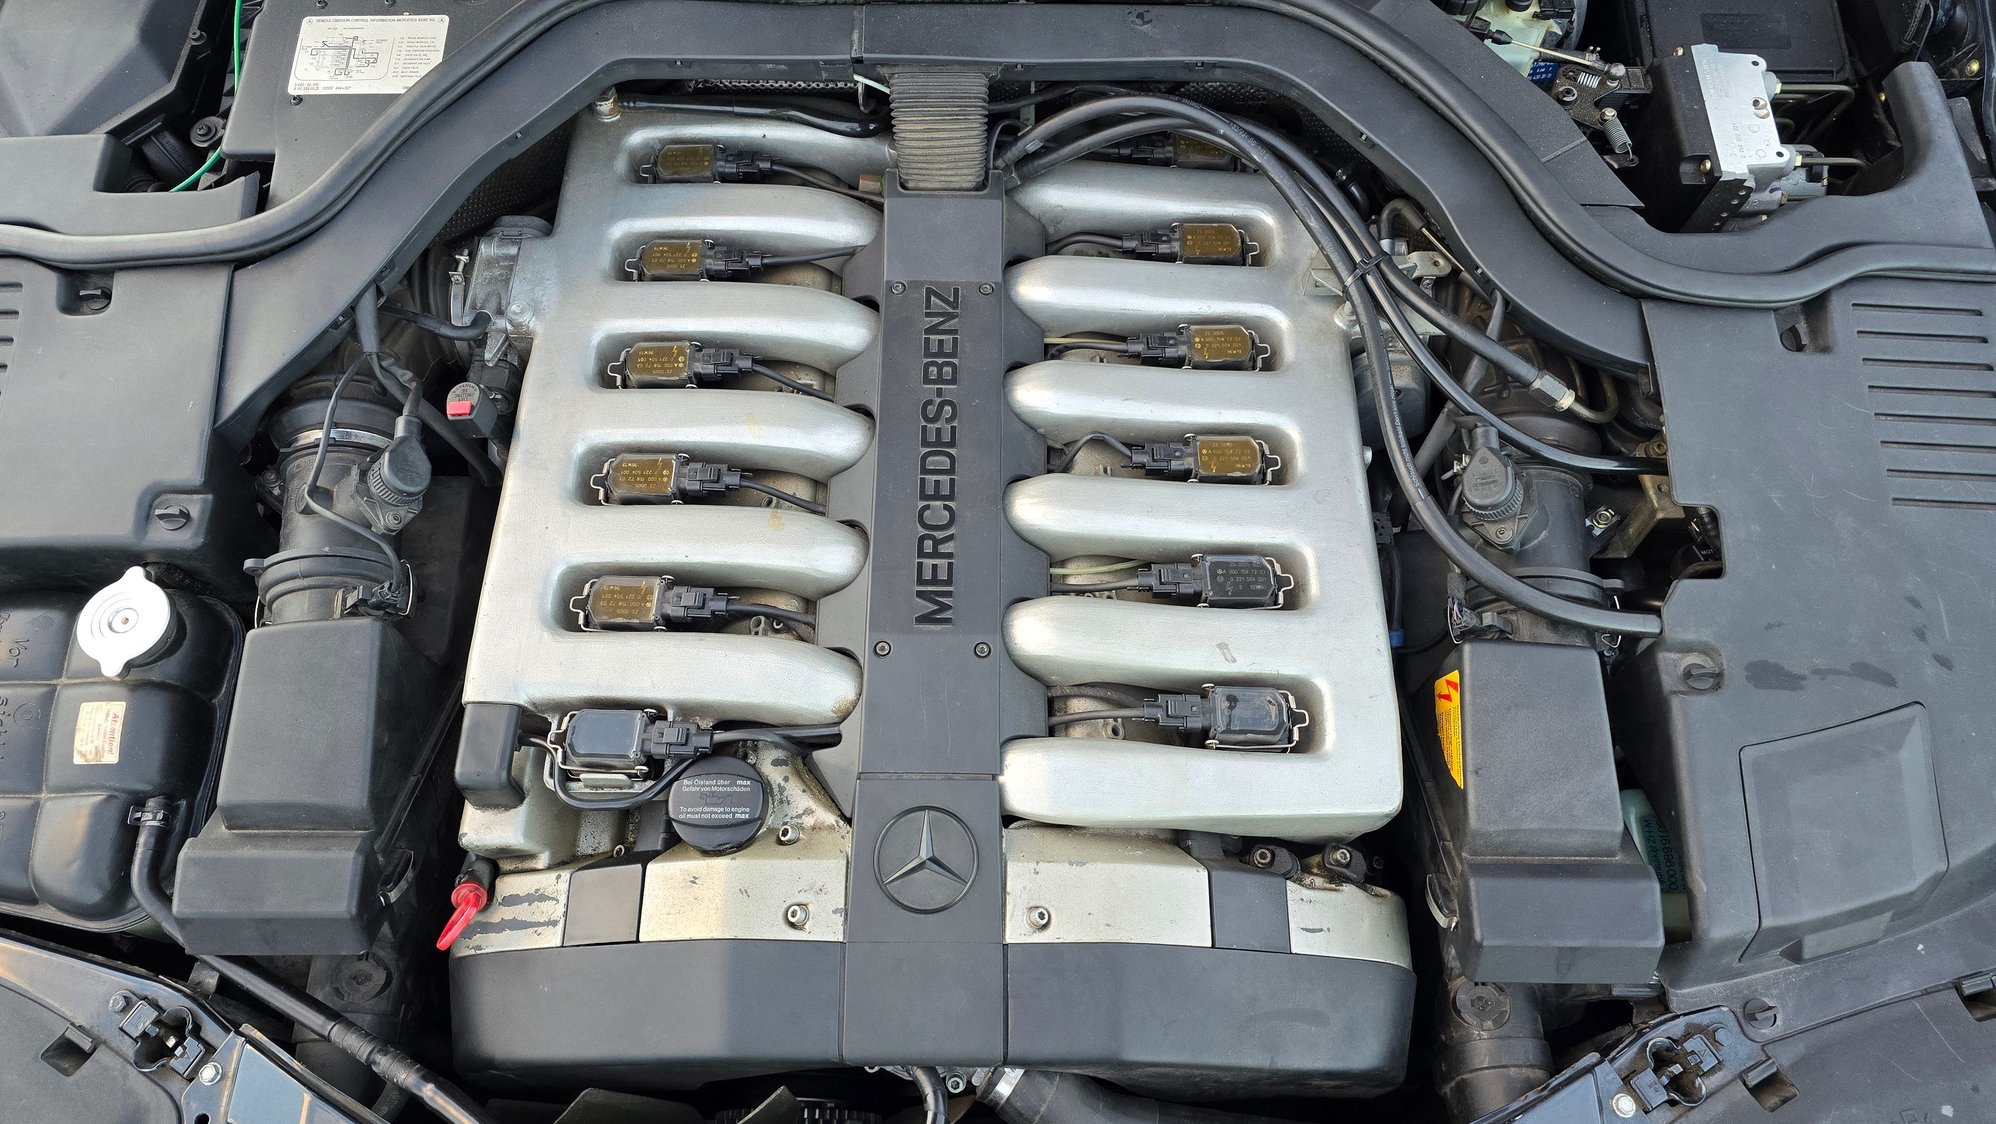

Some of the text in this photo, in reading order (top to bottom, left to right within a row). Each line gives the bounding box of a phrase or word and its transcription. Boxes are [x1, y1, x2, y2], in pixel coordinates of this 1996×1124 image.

[914, 286, 961, 626] MERCEDES-BENZ
[1642, 819, 1656, 843] ZH-M
[1663, 846, 1675, 867] 989
[1666, 869, 1678, 891] 000
